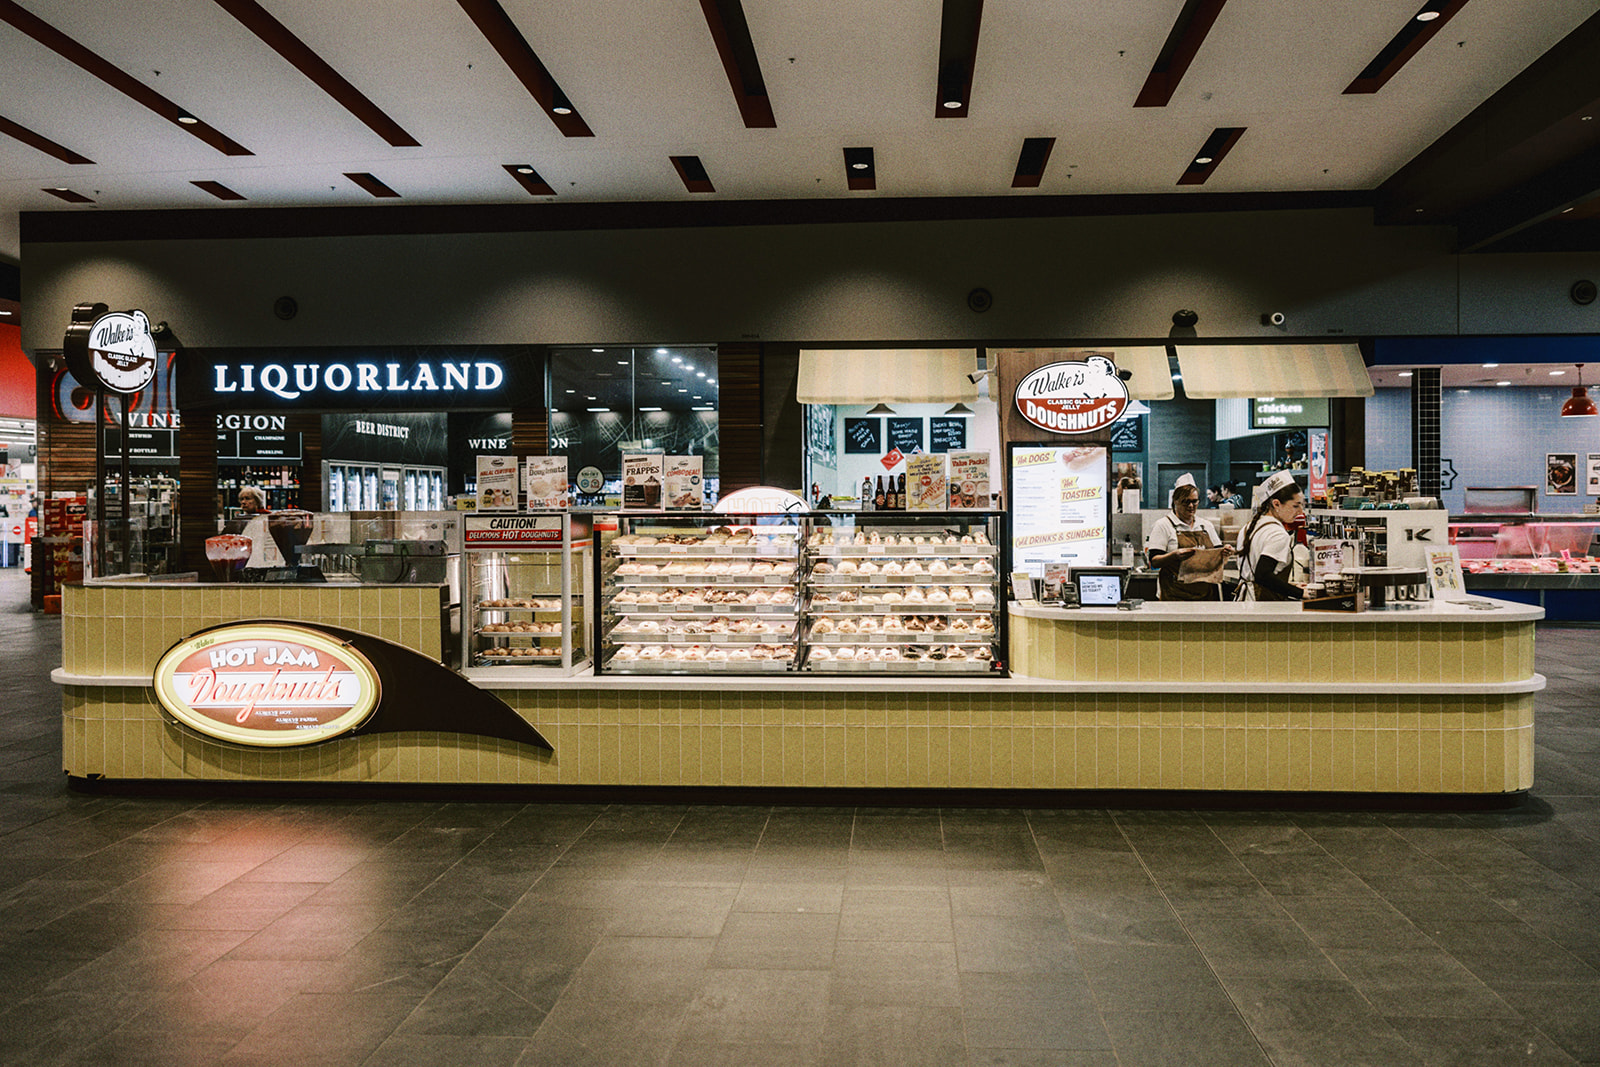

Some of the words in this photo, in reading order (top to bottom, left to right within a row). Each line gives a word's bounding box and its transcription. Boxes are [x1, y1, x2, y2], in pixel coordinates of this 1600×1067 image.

[214, 363, 503, 400] LIQUORLAND
[1028, 370, 1085, 397] Walker's
[1026, 400, 1118, 431] DOUGHNUTS
[1257, 404, 1303, 413] chicken
[217, 415, 286, 431] EGION
[1257, 416, 1287, 424] rules
[355, 421, 376, 435] BEER
[377, 423, 410, 440] DISTRICT
[468, 438, 507, 449] WINE
[1028, 452, 1050, 464] DOGS
[626, 466, 660, 476] FRAPPES
[1062, 488, 1097, 501] TOASTIES
[490, 518, 537, 529] CAUTION!
[502, 530, 520, 540] HOT
[521, 531, 560, 539] DOUGHNUTS
[1028, 532, 1057, 545] DRINKS
[1057, 532, 1064, 541] &
[1066, 527, 1101, 540] SUNDAES
[209, 647, 258, 669] HOT
[262, 647, 320, 669] JAM
[188, 665, 342, 724] Doughnuts
